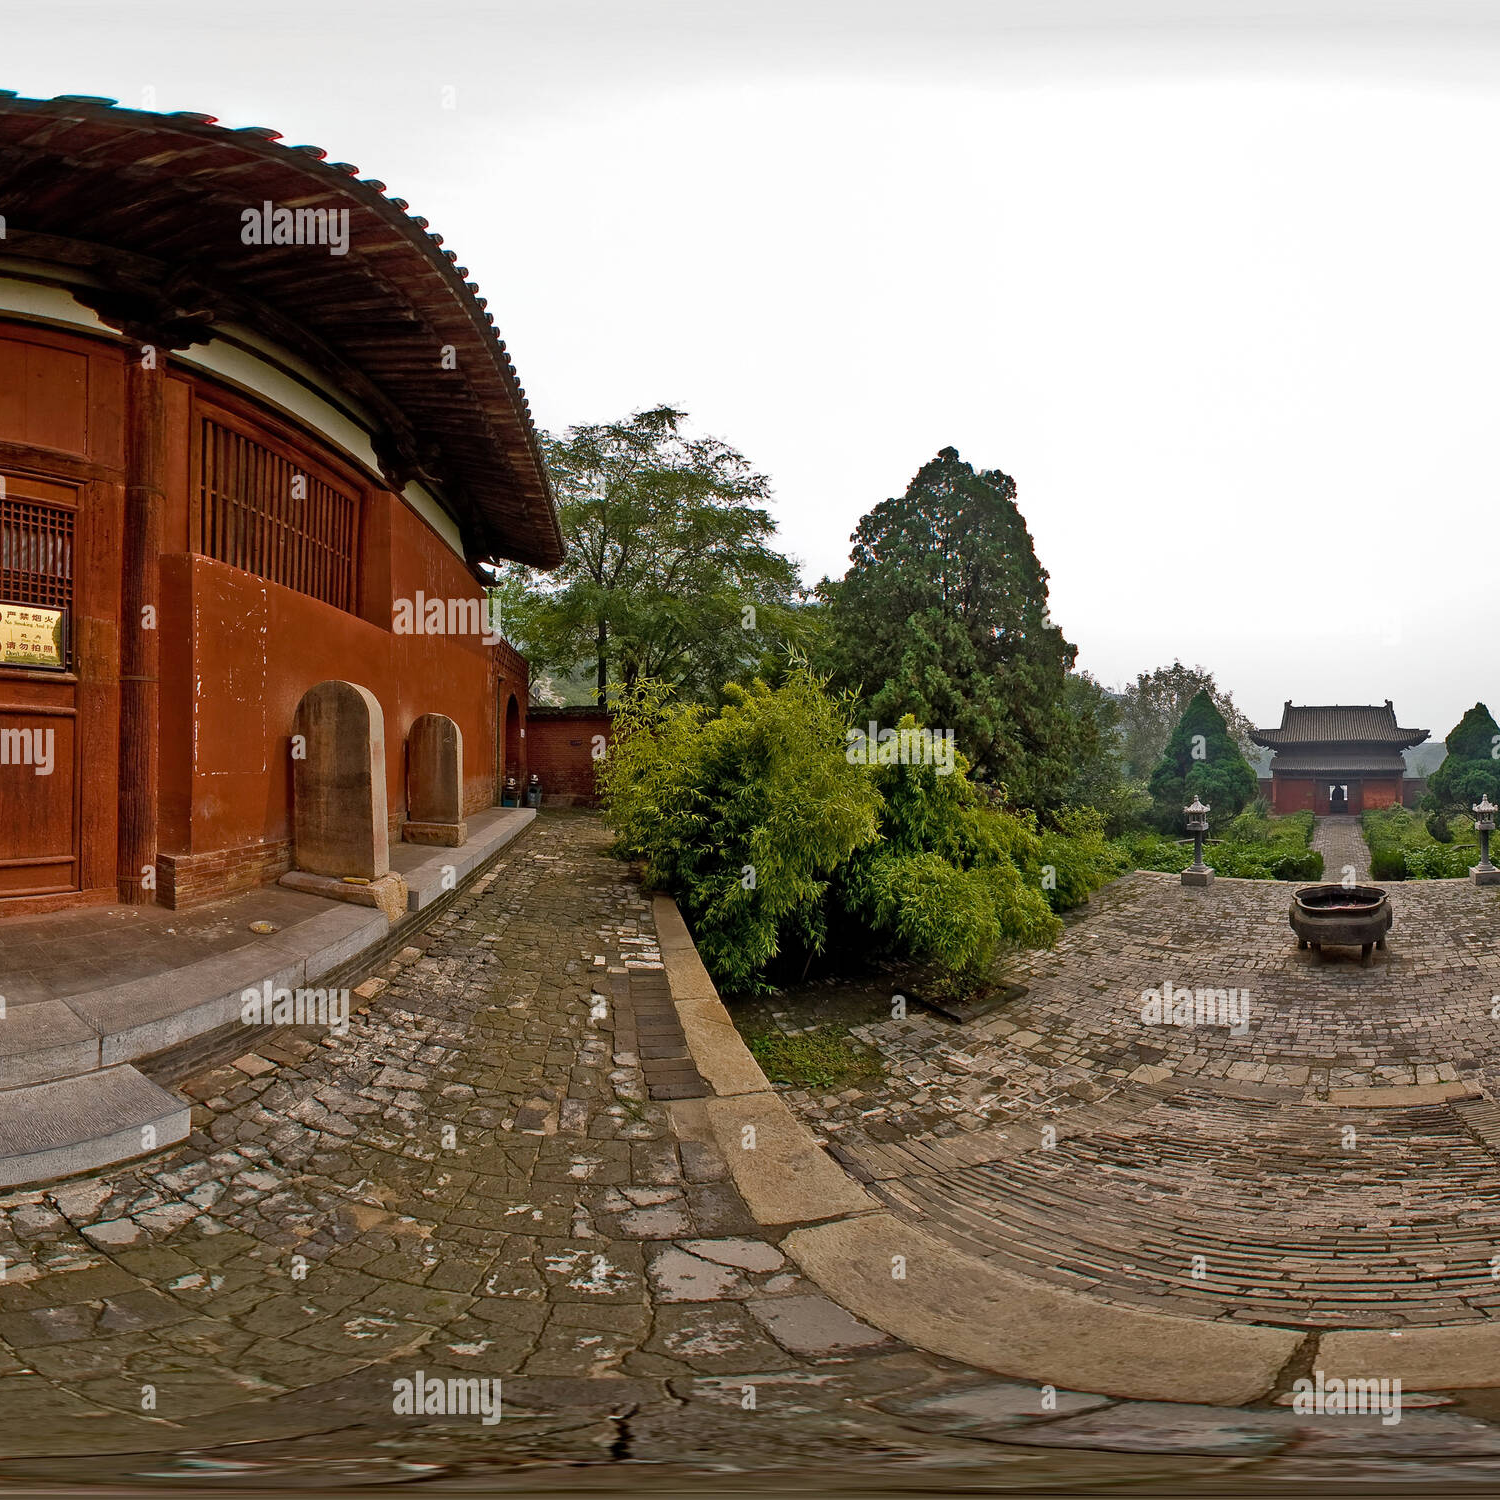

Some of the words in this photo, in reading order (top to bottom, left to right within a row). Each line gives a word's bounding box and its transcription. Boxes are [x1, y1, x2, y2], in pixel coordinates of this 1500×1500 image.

[6, 611, 53, 623] 严禁烟火
[6, 640, 53, 653] 请勿拍照
